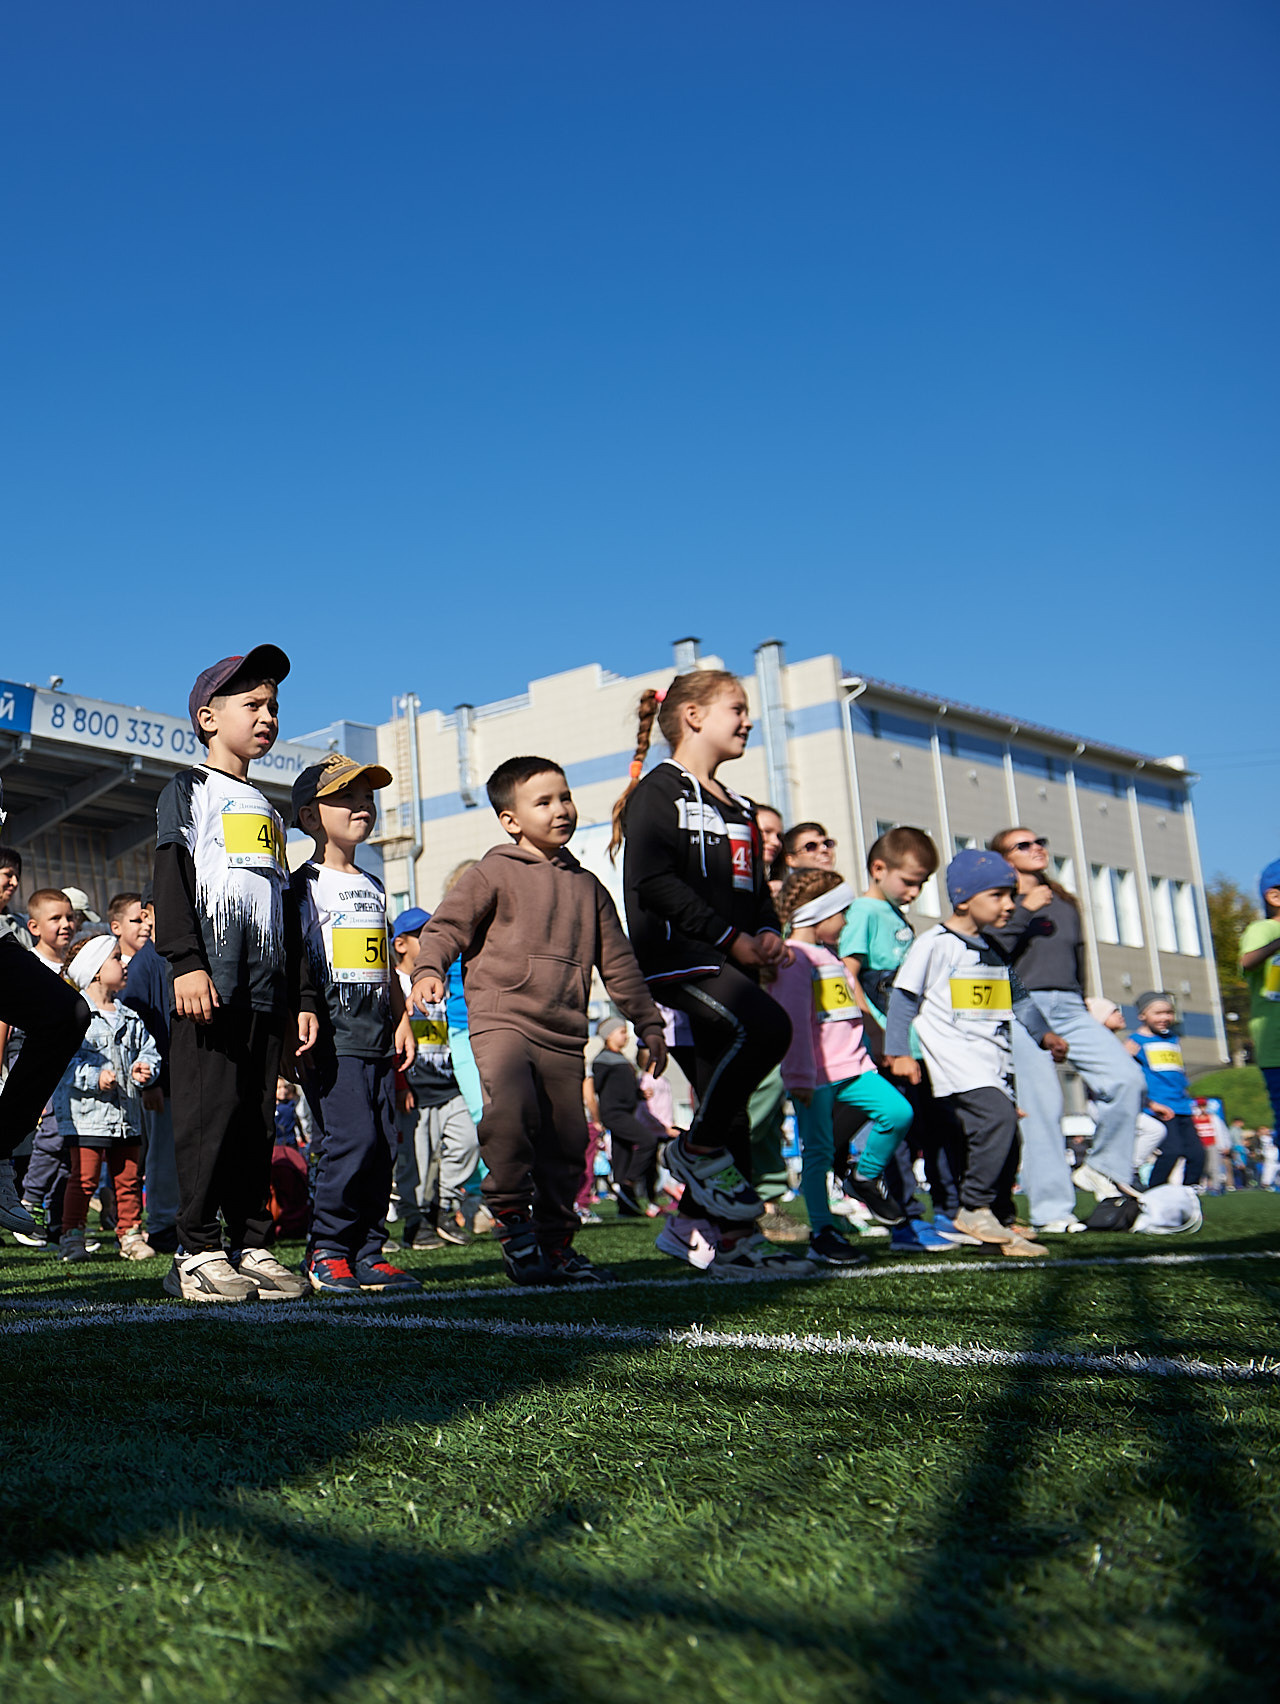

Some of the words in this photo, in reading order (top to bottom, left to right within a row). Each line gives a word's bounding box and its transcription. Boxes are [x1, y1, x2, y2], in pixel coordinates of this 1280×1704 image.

[51, 703, 65, 728] 8
[73, 708, 119, 738] 800
[125, 718, 164, 748] 333
[171, 728, 197, 754] 03
[972, 985, 993, 1006] 57
